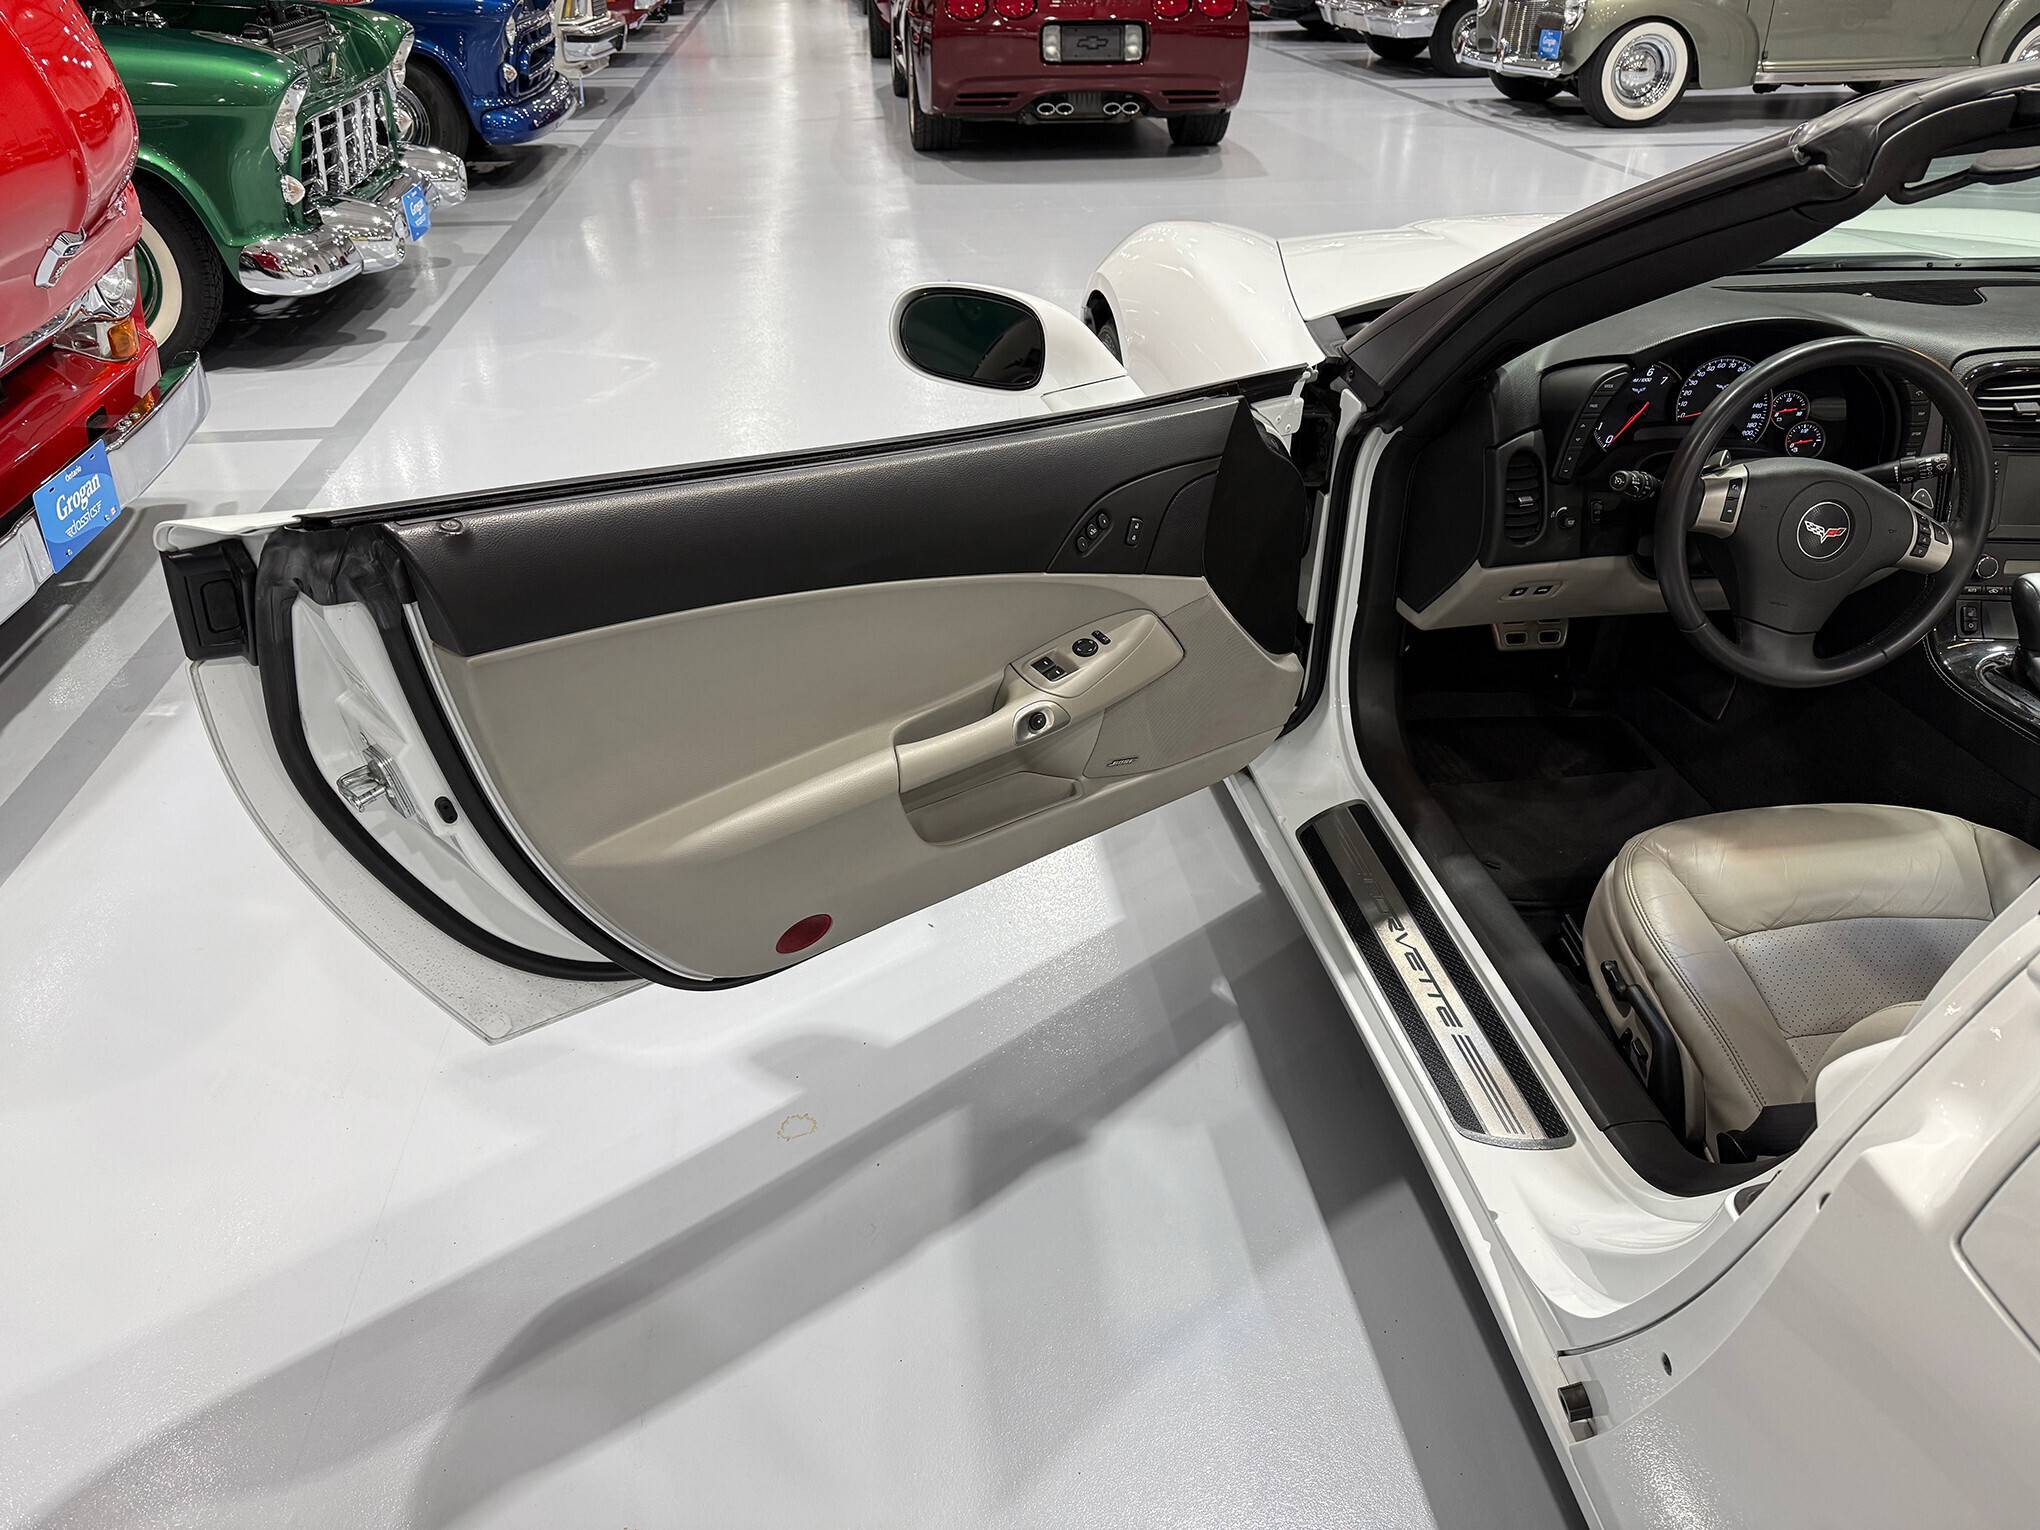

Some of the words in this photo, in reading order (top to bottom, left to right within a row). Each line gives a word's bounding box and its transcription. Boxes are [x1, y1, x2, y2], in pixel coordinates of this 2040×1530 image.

[1646, 368, 1655, 376] 6
[1660, 376, 1668, 384] 7
[1606, 435, 1614, 444] 0
[56, 473, 101, 521] Grogan
